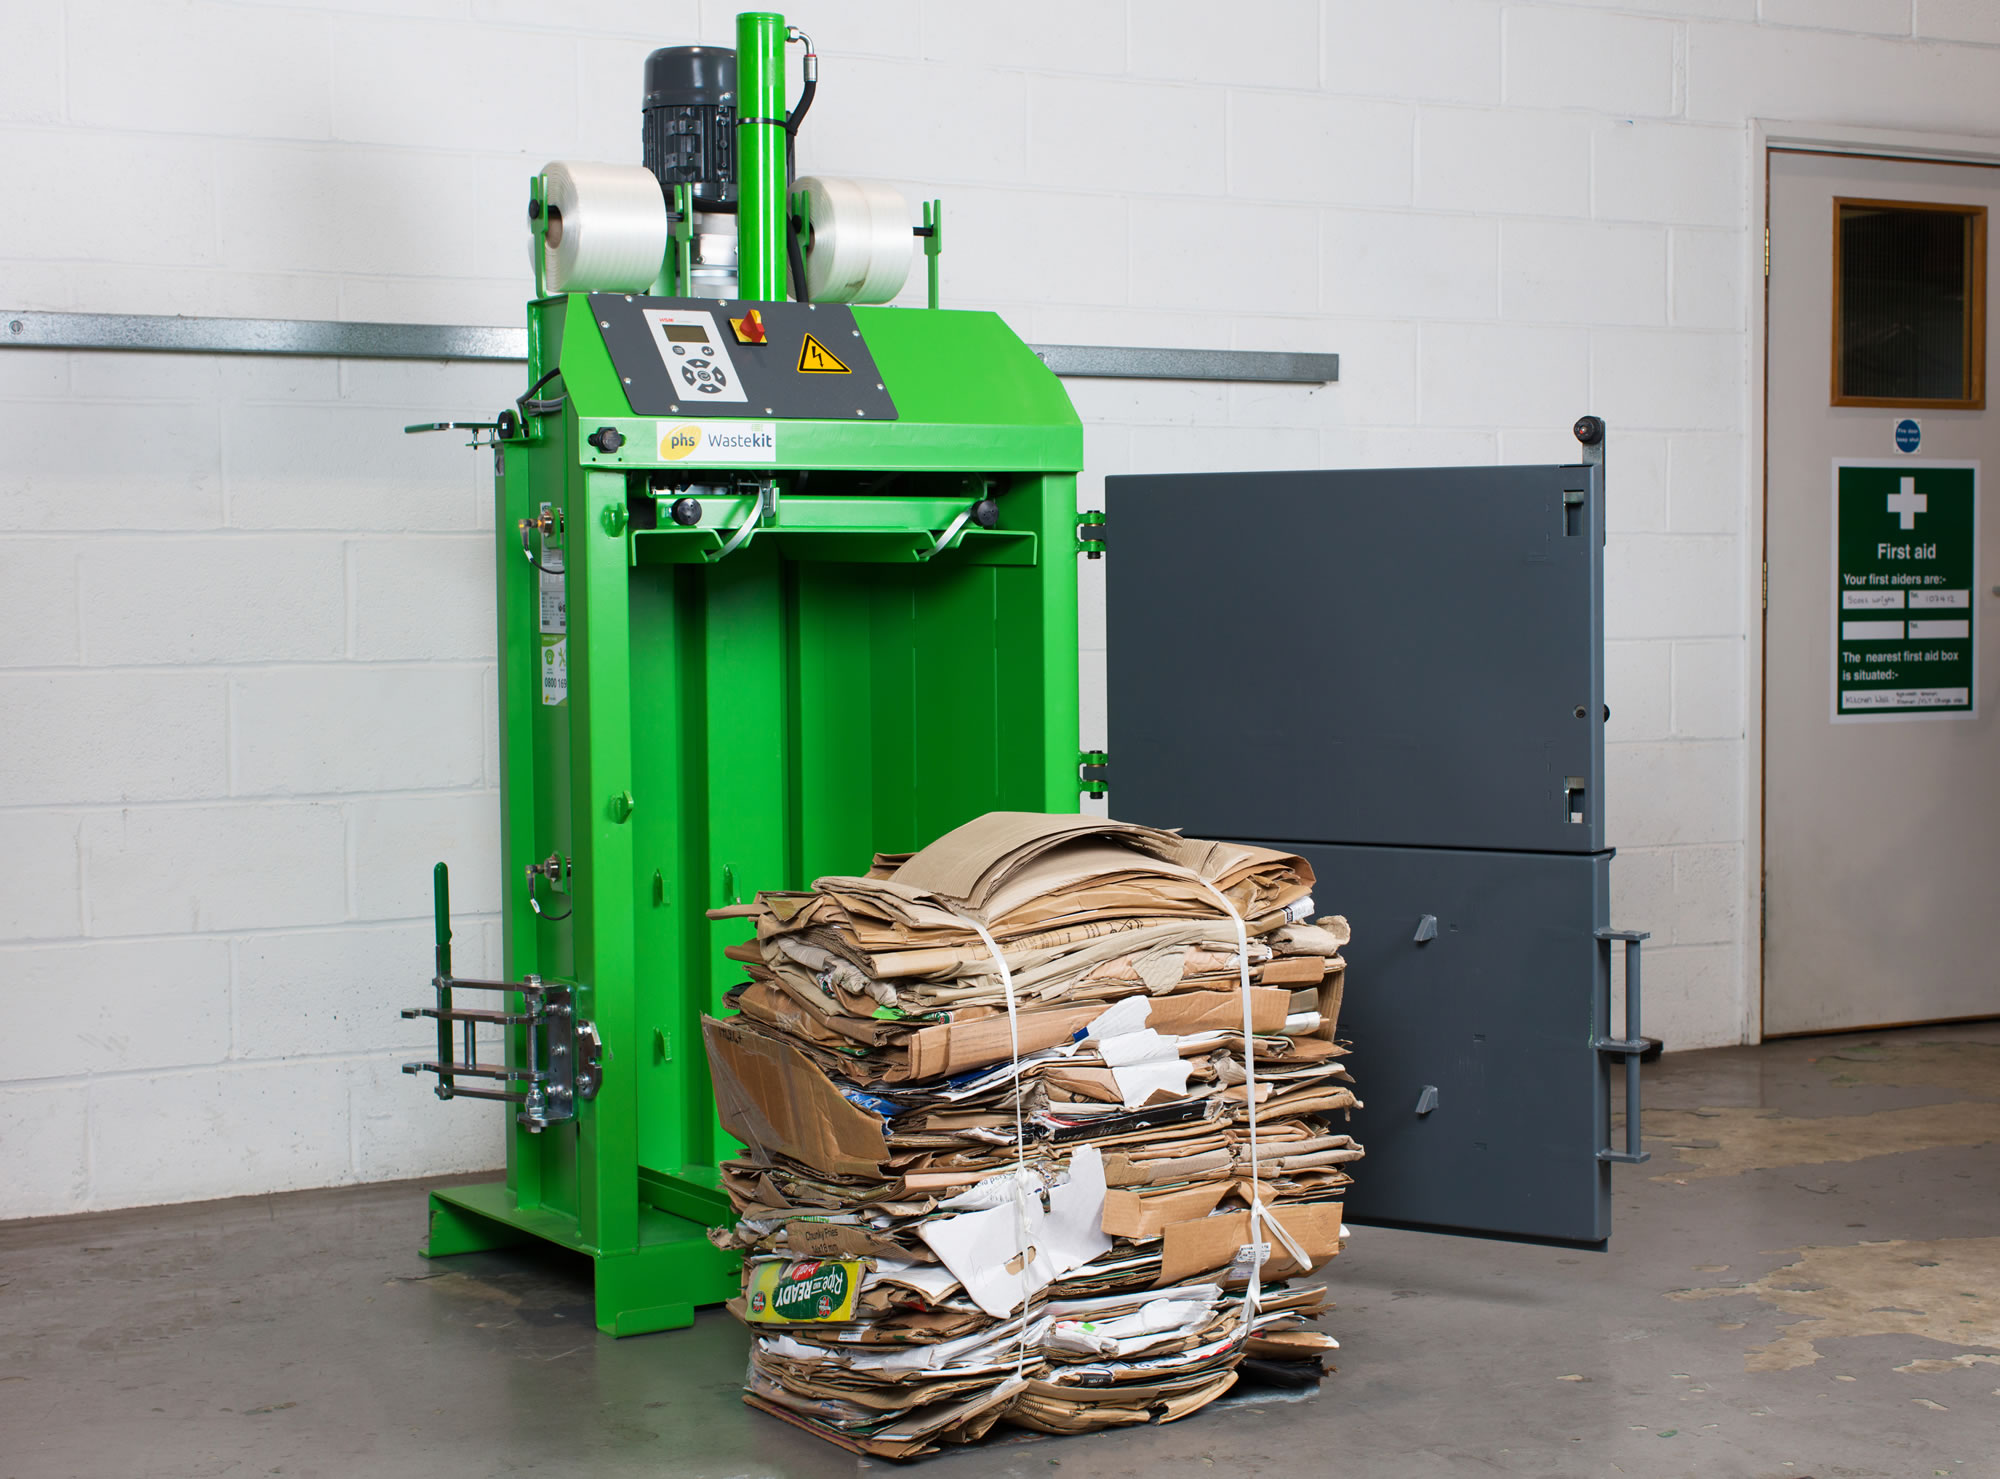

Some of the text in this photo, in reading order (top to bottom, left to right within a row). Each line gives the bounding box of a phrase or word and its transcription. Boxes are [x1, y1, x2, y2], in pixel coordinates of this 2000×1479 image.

[671, 431, 772, 449] phs Wastekit
[1878, 543, 1936, 559] First aid
[1843, 573, 1947, 585] Your first aiders are:-
[1843, 650, 1959, 663] The nearest first aid box
[1842, 669, 1899, 681] is situated:-
[544, 677, 557, 688] 0800
[805, 1227, 838, 1241] Chunky Fries
[822, 1266, 844, 1295] Ripe
[775, 1280, 813, 1307] READY
